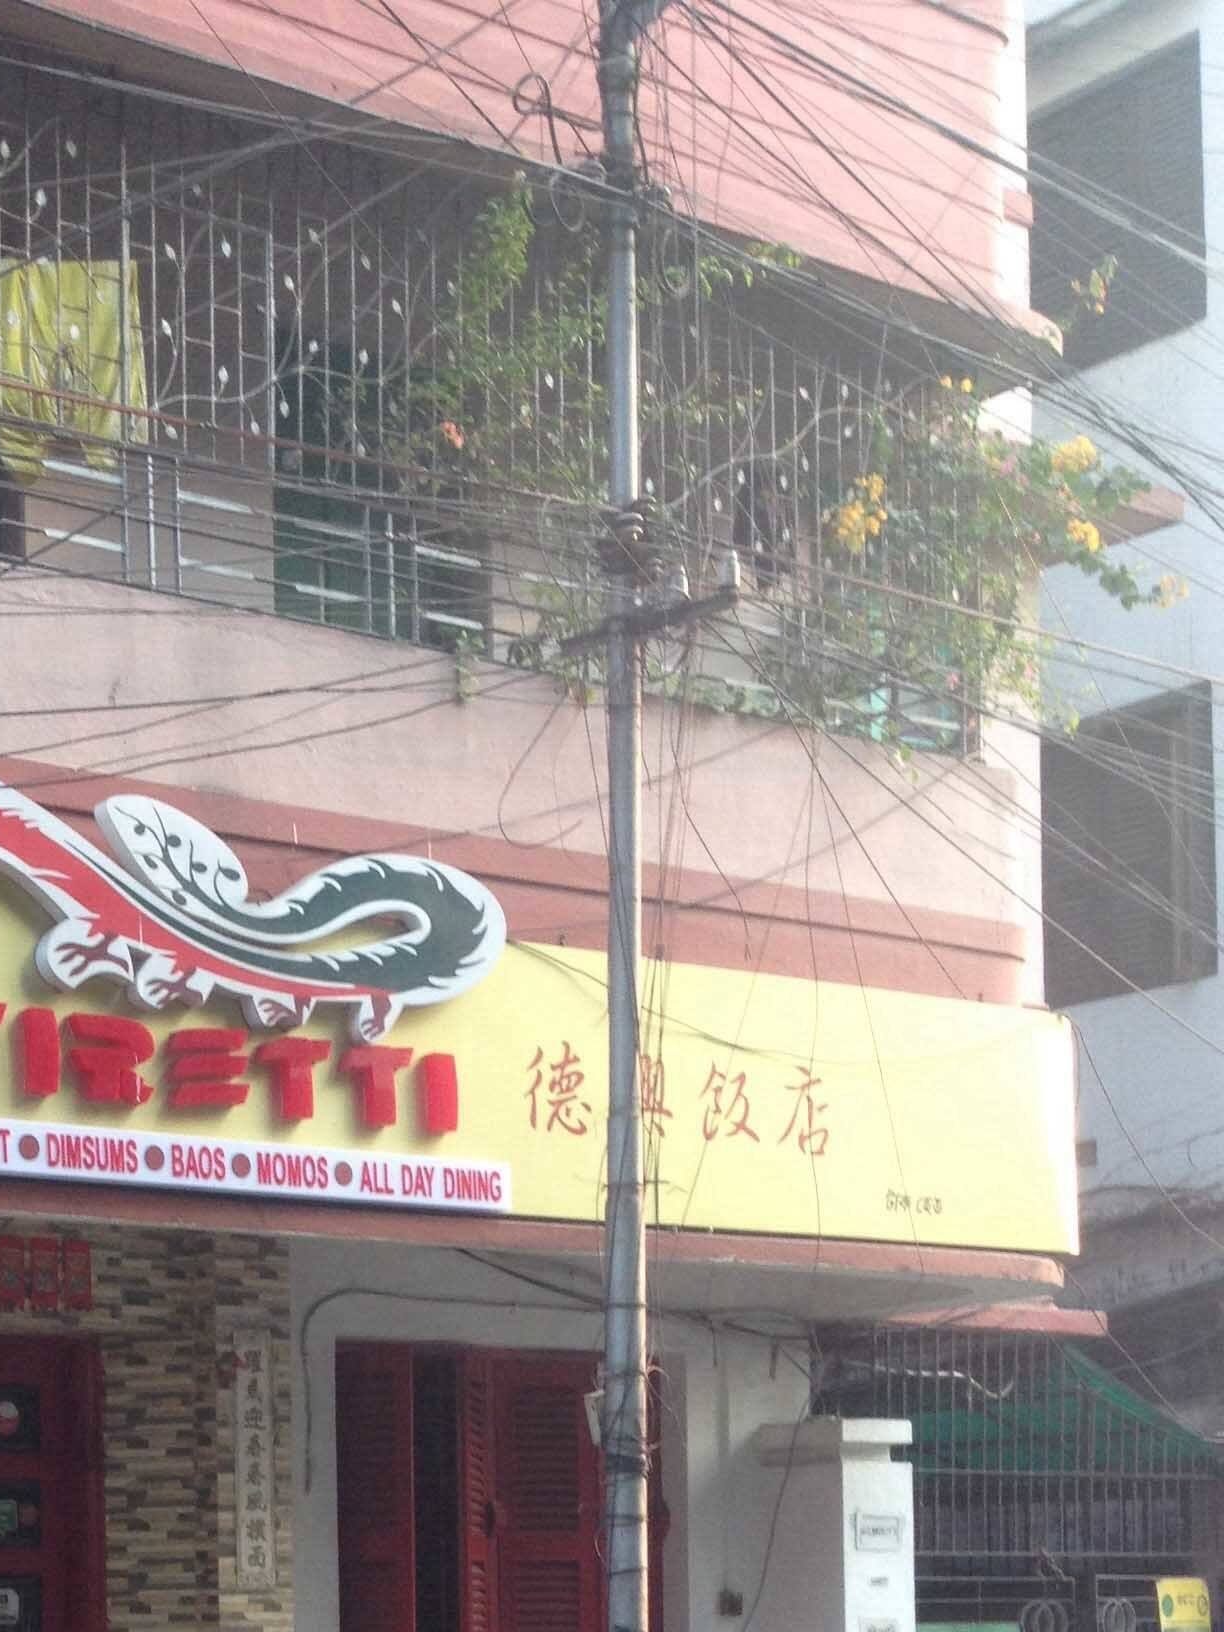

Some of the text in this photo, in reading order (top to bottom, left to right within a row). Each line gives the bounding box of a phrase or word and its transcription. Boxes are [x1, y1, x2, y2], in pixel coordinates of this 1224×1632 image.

[46, 1132, 138, 1174] DIMSUMS
[170, 1143, 226, 1181] BAOS
[257, 1154, 329, 1190] MOMOS
[360, 1160, 394, 1194] ALL
[401, 1164, 437, 1198] DAY
[444, 1166, 503, 1203] DINING
